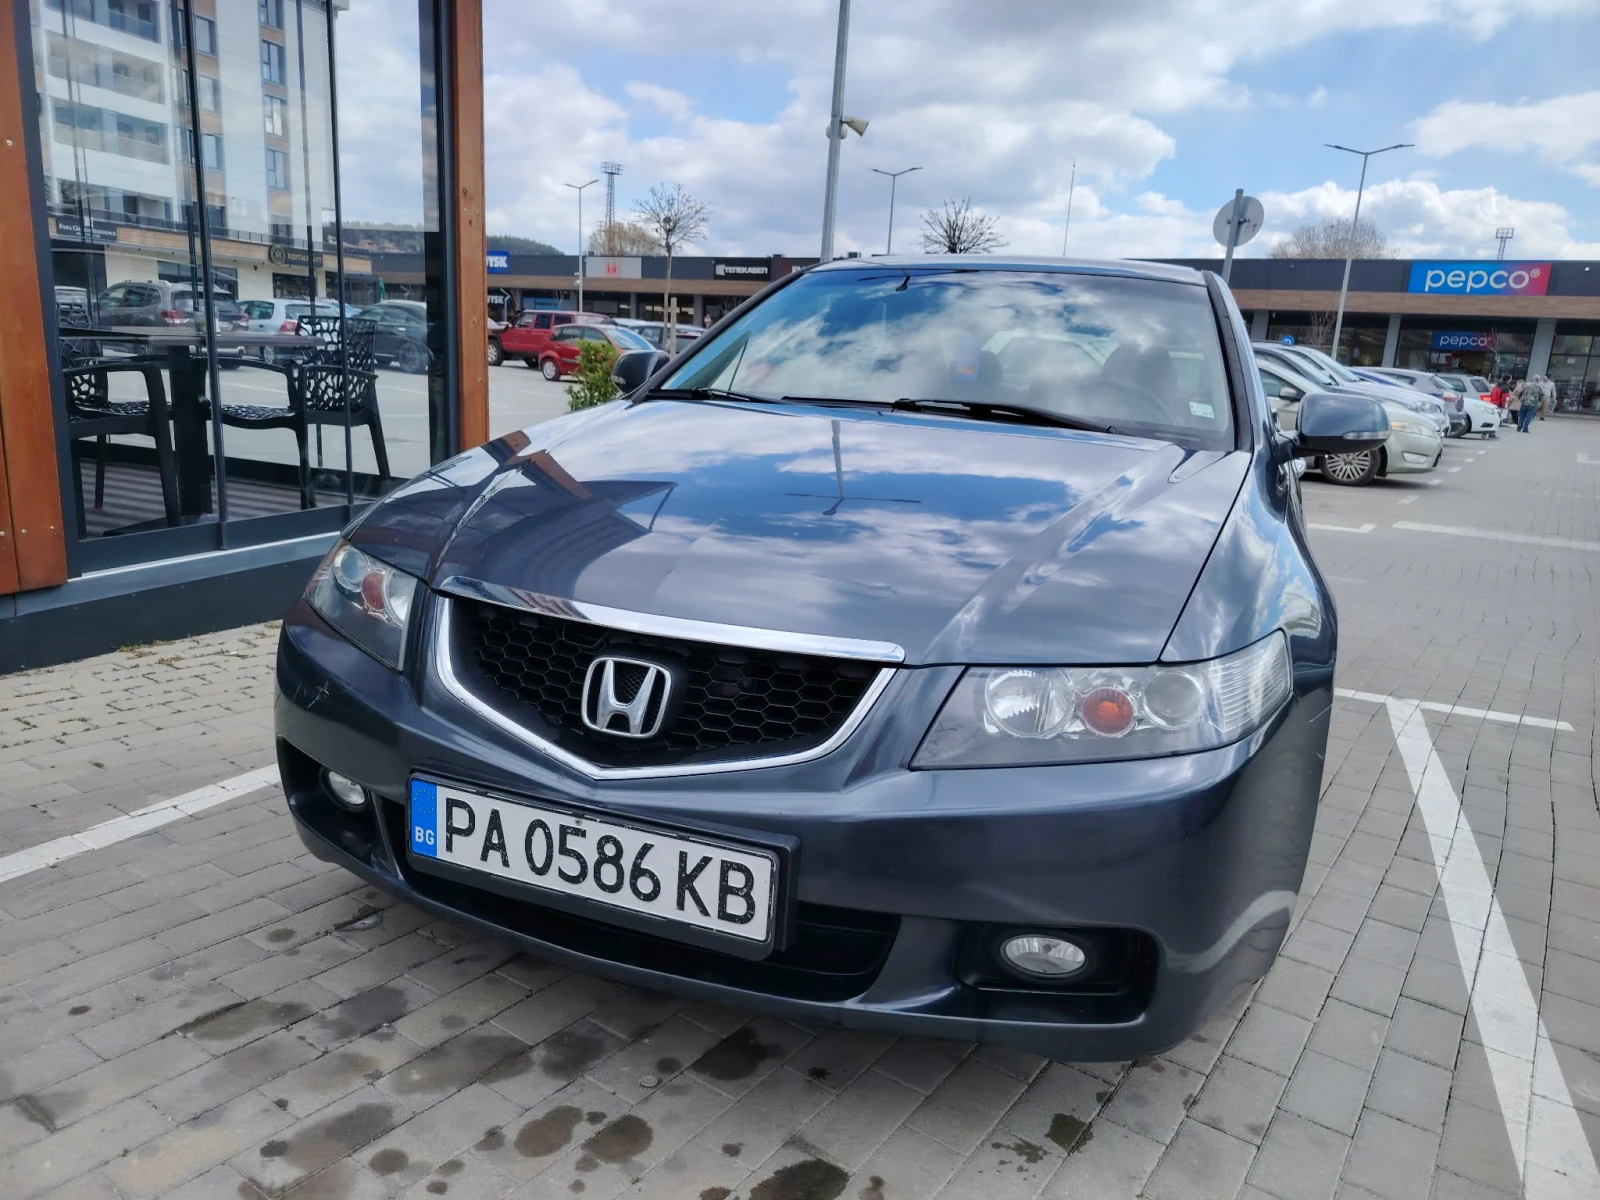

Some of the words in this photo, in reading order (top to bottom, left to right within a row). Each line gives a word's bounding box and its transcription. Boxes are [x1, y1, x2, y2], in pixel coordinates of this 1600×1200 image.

[287, 252, 322, 264] RESTAUANT
[415, 826, 435, 846] BG
[445, 797, 511, 868] PA
[524, 818, 662, 902] 0586
[676, 850, 757, 925] KB
